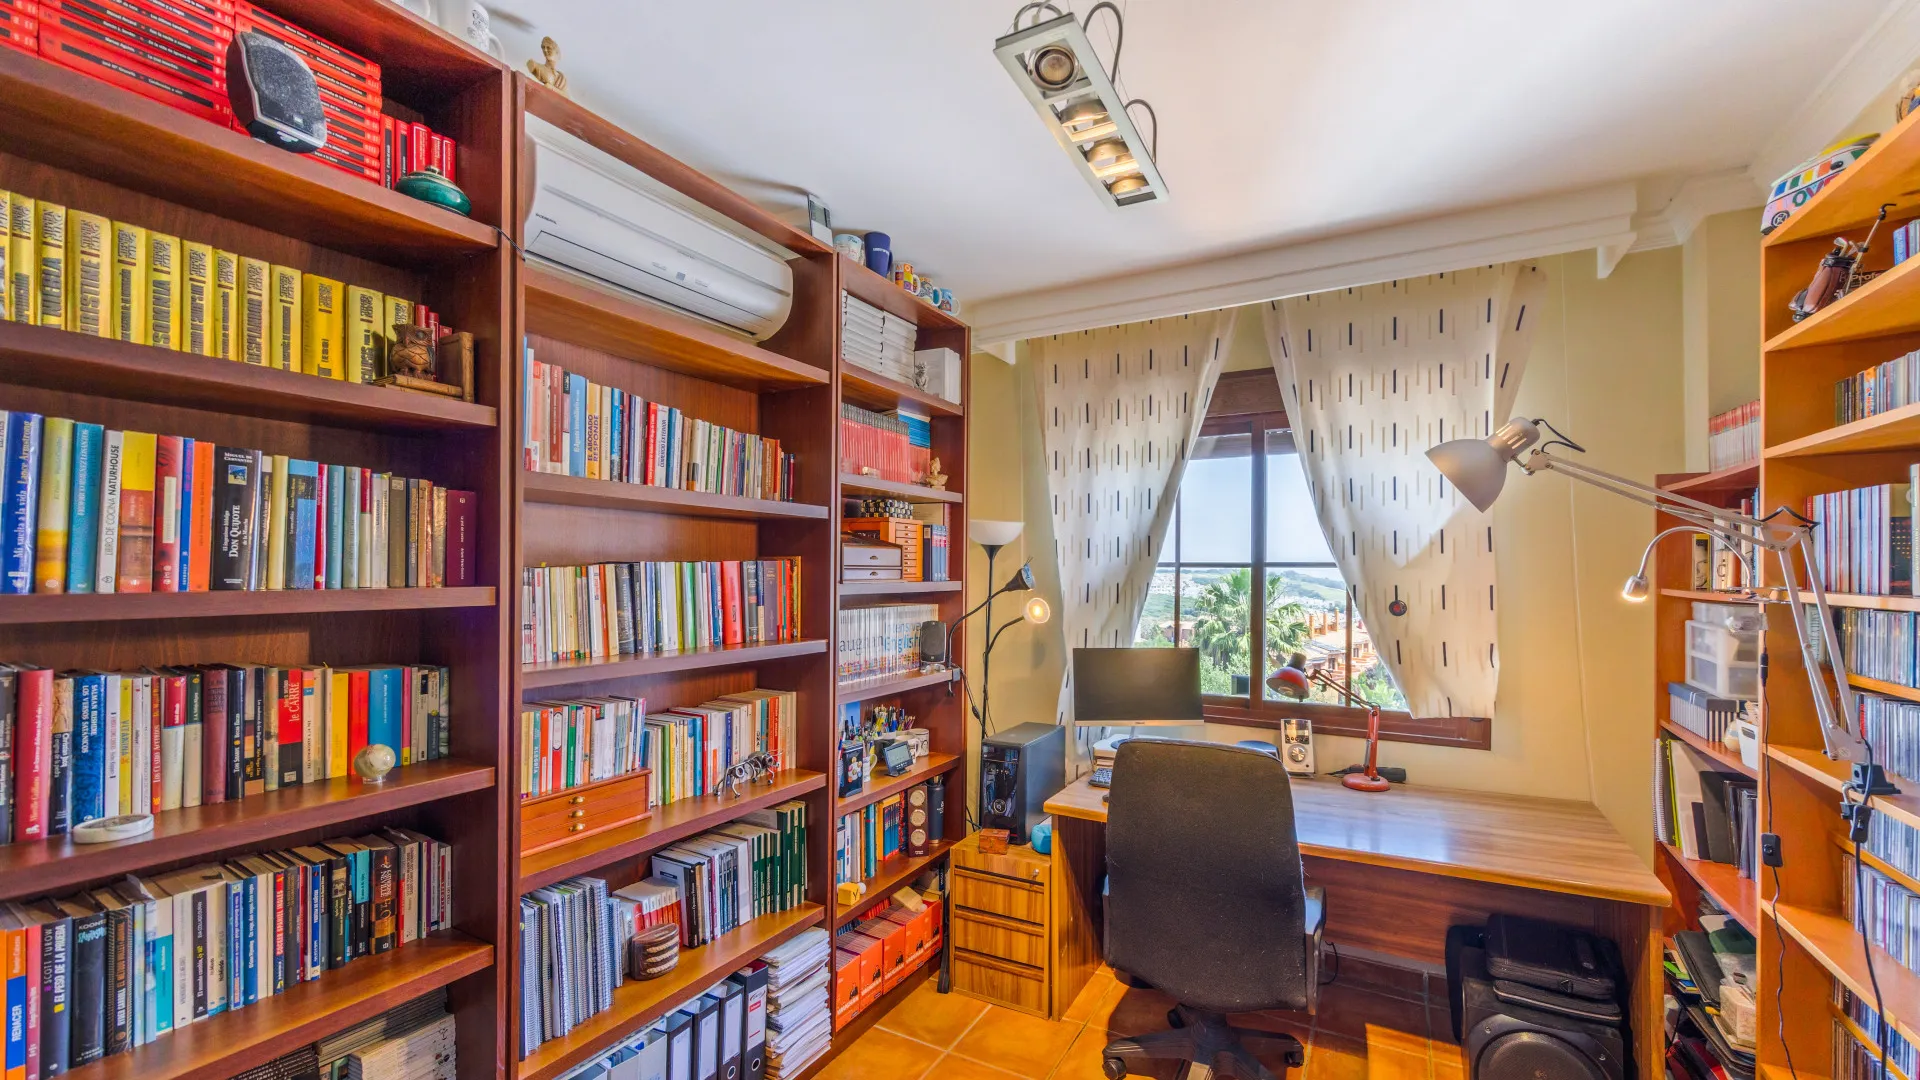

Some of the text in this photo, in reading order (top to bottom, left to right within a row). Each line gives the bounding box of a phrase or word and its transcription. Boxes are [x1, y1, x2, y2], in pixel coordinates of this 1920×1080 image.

[42, 257, 61, 316] NIEBLA
[80, 259, 100, 335] HRISTINE
[152, 280, 170, 349] SOMNIA
[361, 346, 373, 383] CALIPSIS
[19, 421, 32, 460] Armstrong
[104, 445, 120, 555] LIBRO DE COCINA NATURHOUSE
[14, 522, 26, 546] vuelta
[229, 505, 241, 557] DON QUIJOTE
[840, 635, 883, 656] aughan
[81, 698, 89, 720] VERSOS
[90, 685, 98, 710] SALMAN
[289, 682, 300, 722] le CARRÉ
[81, 721, 90, 753] SATÁNICOS
[276, 910, 284, 955] COCKER SPANIEL
[44, 928, 52, 984] SCOTT TUROW
[54, 924, 66, 1002] EL PESO DE LA PRUEBA
[12, 1004, 22, 1042] RENACER
